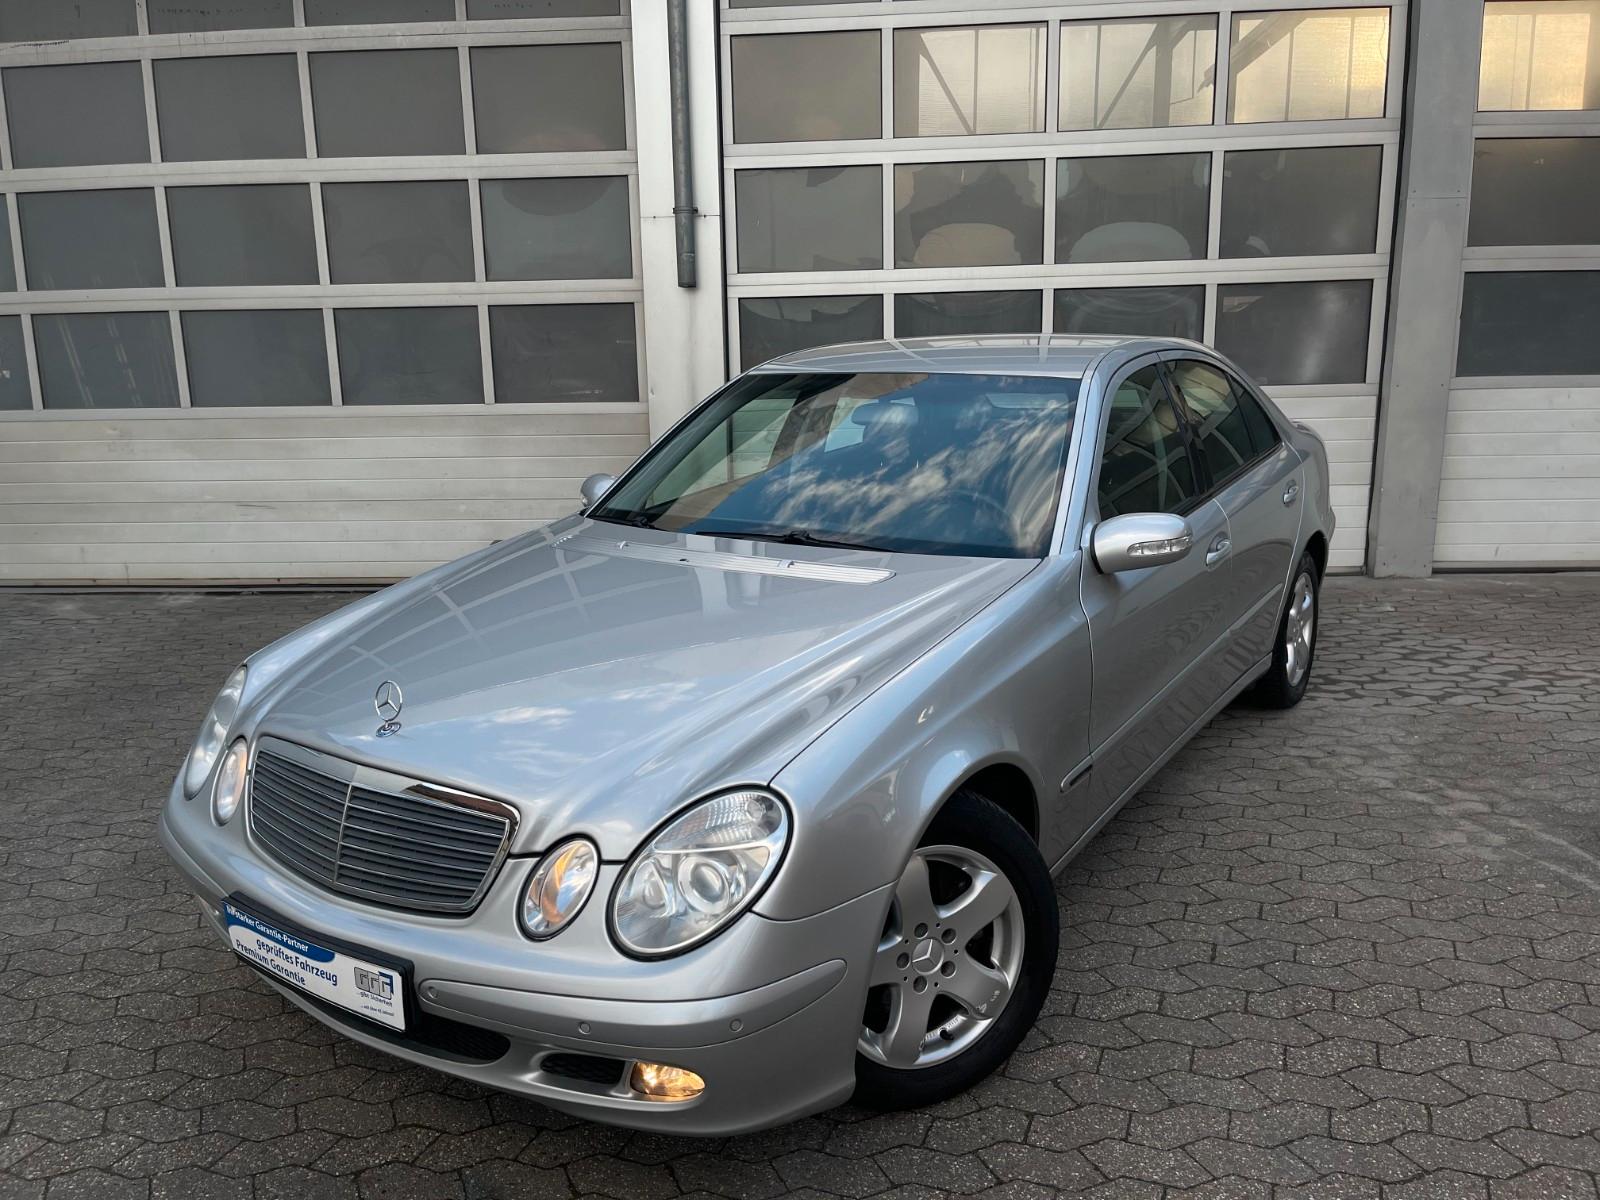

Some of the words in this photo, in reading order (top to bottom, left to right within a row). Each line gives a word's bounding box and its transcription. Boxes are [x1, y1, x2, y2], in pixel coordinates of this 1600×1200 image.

[255, 921, 309, 952] Garantie-Partner
[235, 939, 270, 966] Premium
[270, 959, 306, 986] Garantie
[256, 939, 294, 964] geprüftes
[295, 956, 338, 986] Fahrzeug
